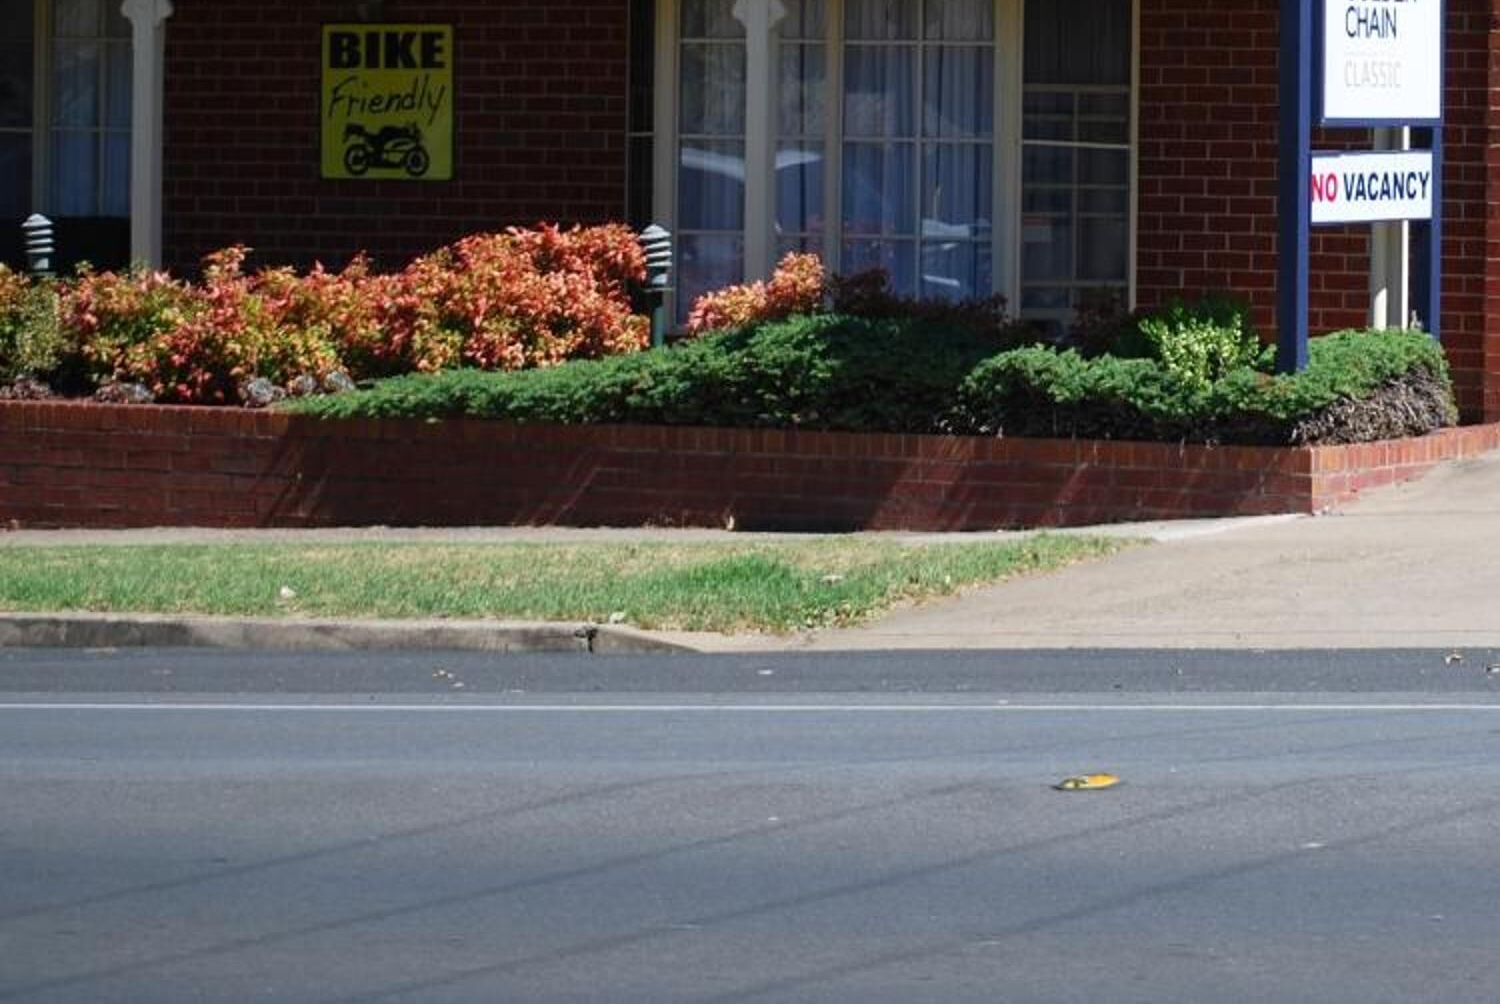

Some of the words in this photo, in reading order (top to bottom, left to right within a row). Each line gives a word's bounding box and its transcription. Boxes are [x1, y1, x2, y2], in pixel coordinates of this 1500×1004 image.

[1345, 6, 1398, 39] CHAIN
[329, 32, 446, 69] BIKE
[1344, 60, 1403, 89] CLASSIC
[329, 73, 446, 126] Friendly
[1311, 173, 1338, 202] NO
[1343, 171, 1430, 201] VACANCY
